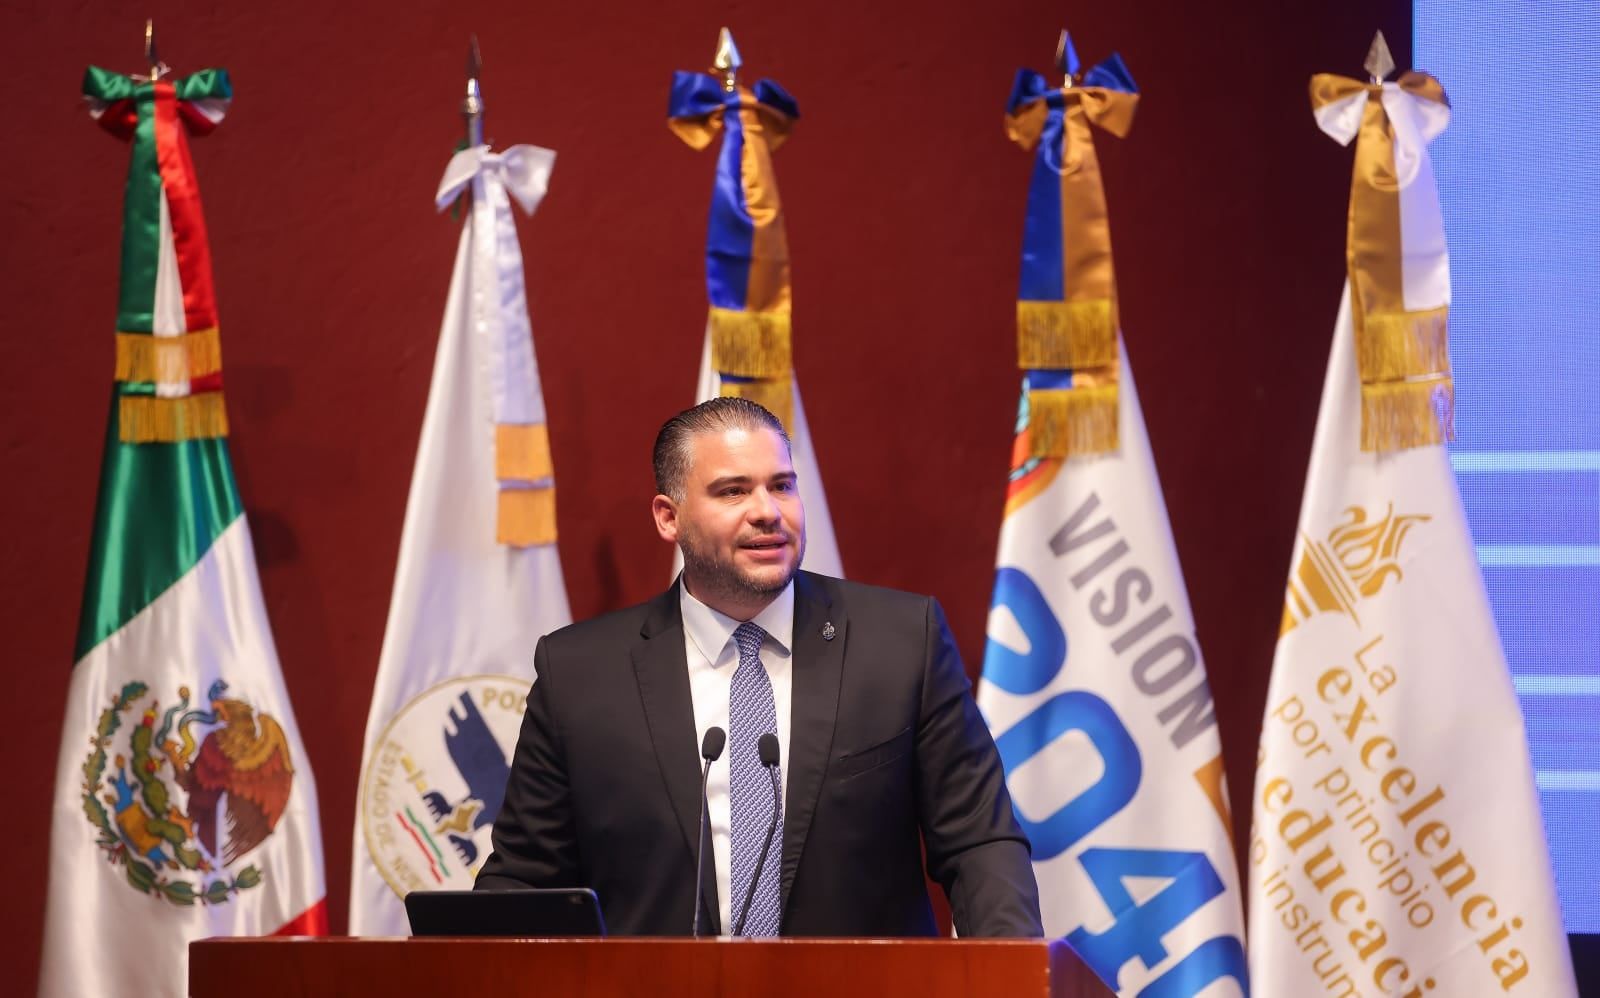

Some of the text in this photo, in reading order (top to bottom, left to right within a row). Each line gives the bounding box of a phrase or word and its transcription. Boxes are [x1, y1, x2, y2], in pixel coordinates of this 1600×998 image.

[1048, 493, 1217, 750] VISION
[1354, 635, 1396, 695] La
[1272, 694, 1435, 930] por principio
[1316, 666, 1530, 991] excelencia
